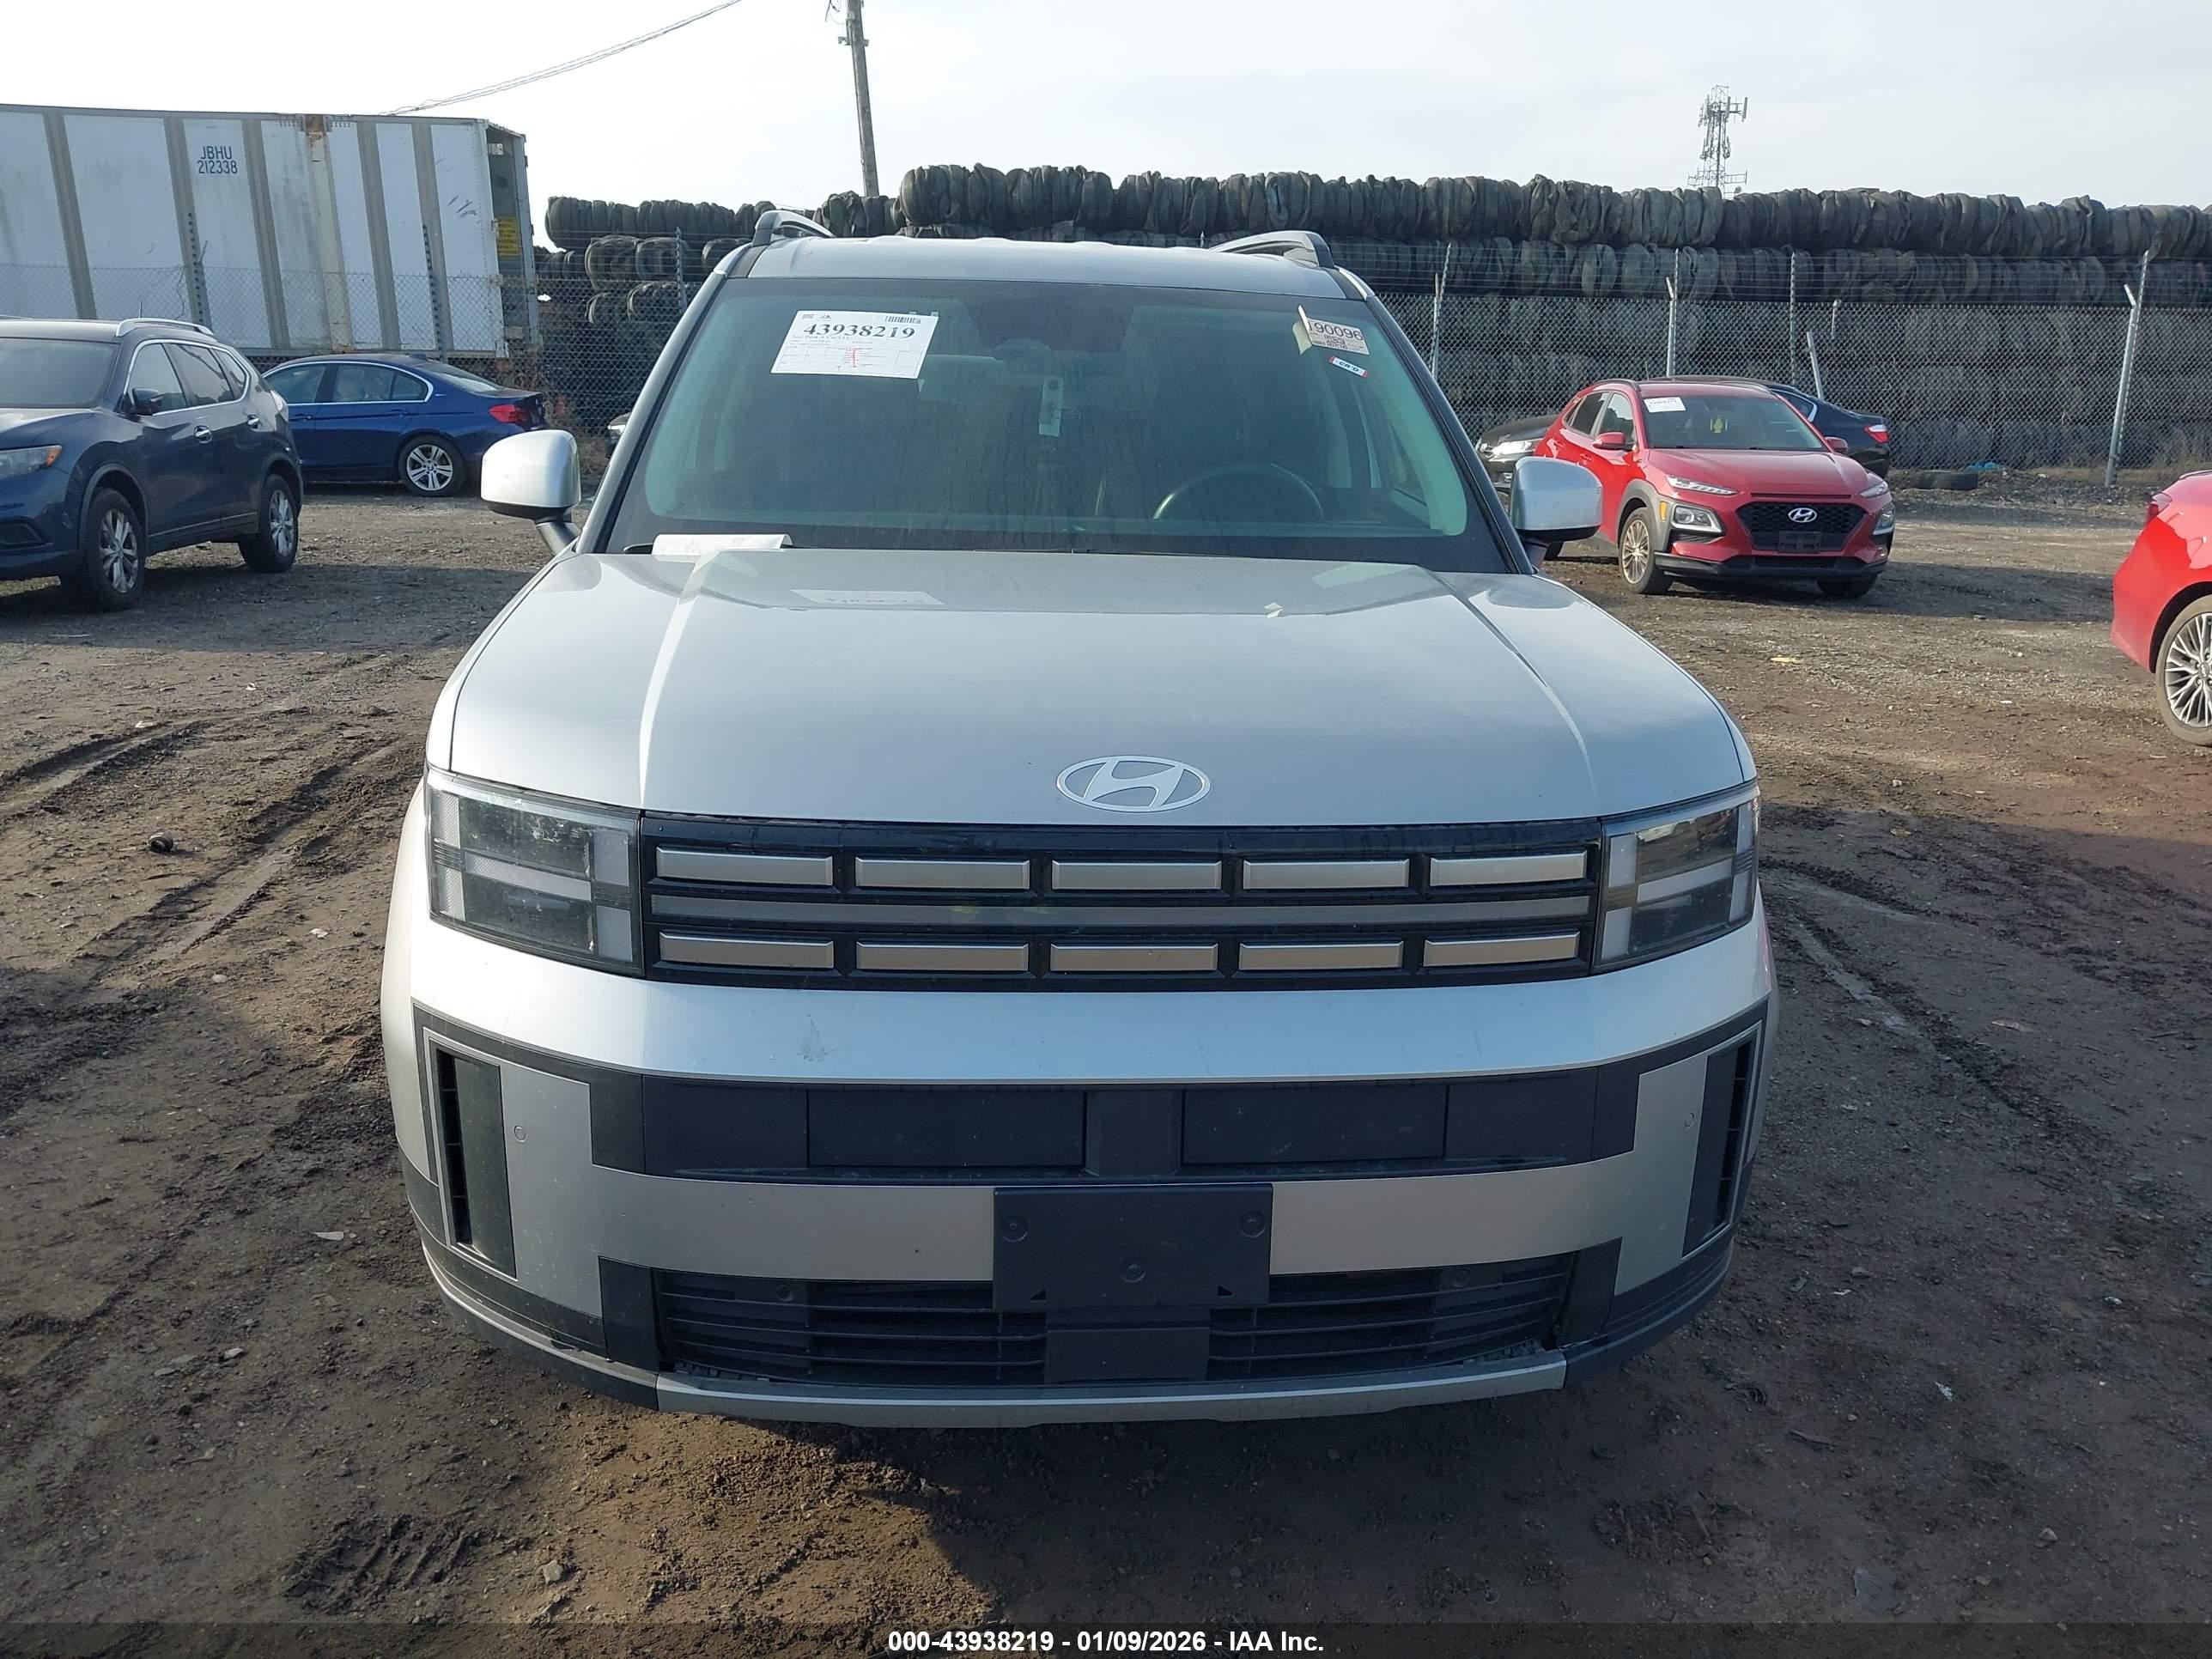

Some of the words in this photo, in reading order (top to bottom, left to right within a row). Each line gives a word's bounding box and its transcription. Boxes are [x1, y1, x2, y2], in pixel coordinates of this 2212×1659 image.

[200, 145, 232, 160] JBHU
[197, 160, 238, 174] 212338
[803, 323, 916, 339] 43938219
[1308, 320, 1364, 342] 190096
